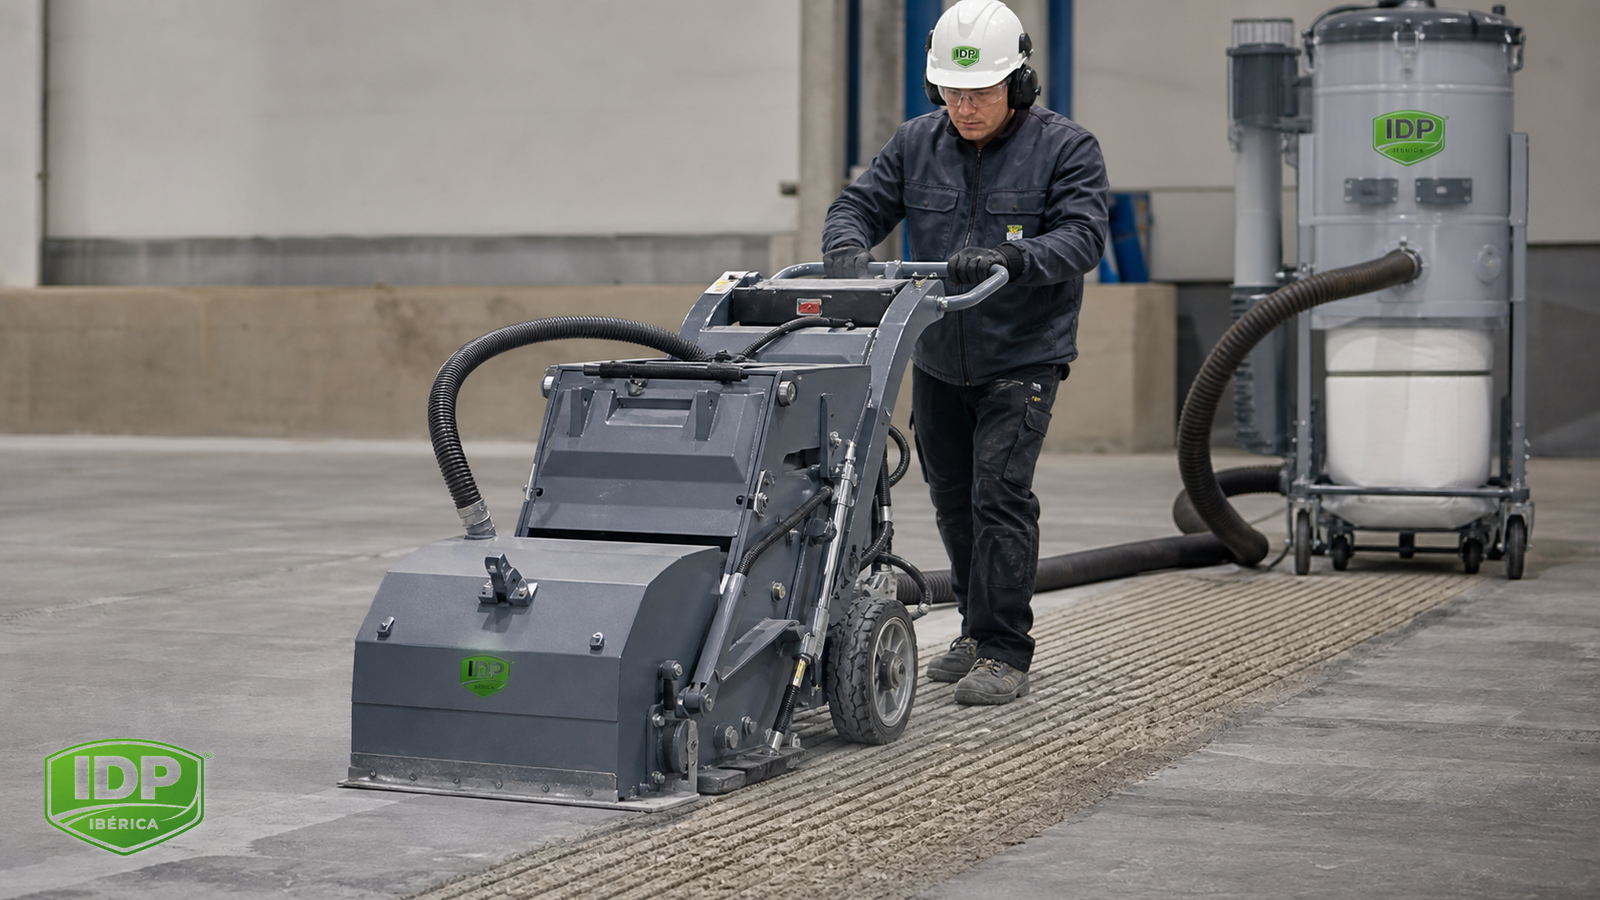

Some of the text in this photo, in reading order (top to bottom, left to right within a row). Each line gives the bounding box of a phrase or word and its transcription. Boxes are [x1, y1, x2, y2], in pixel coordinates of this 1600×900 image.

[956, 49, 976, 59] IDP
[1386, 118, 1435, 140] IDP
[468, 660, 504, 679] IDP
